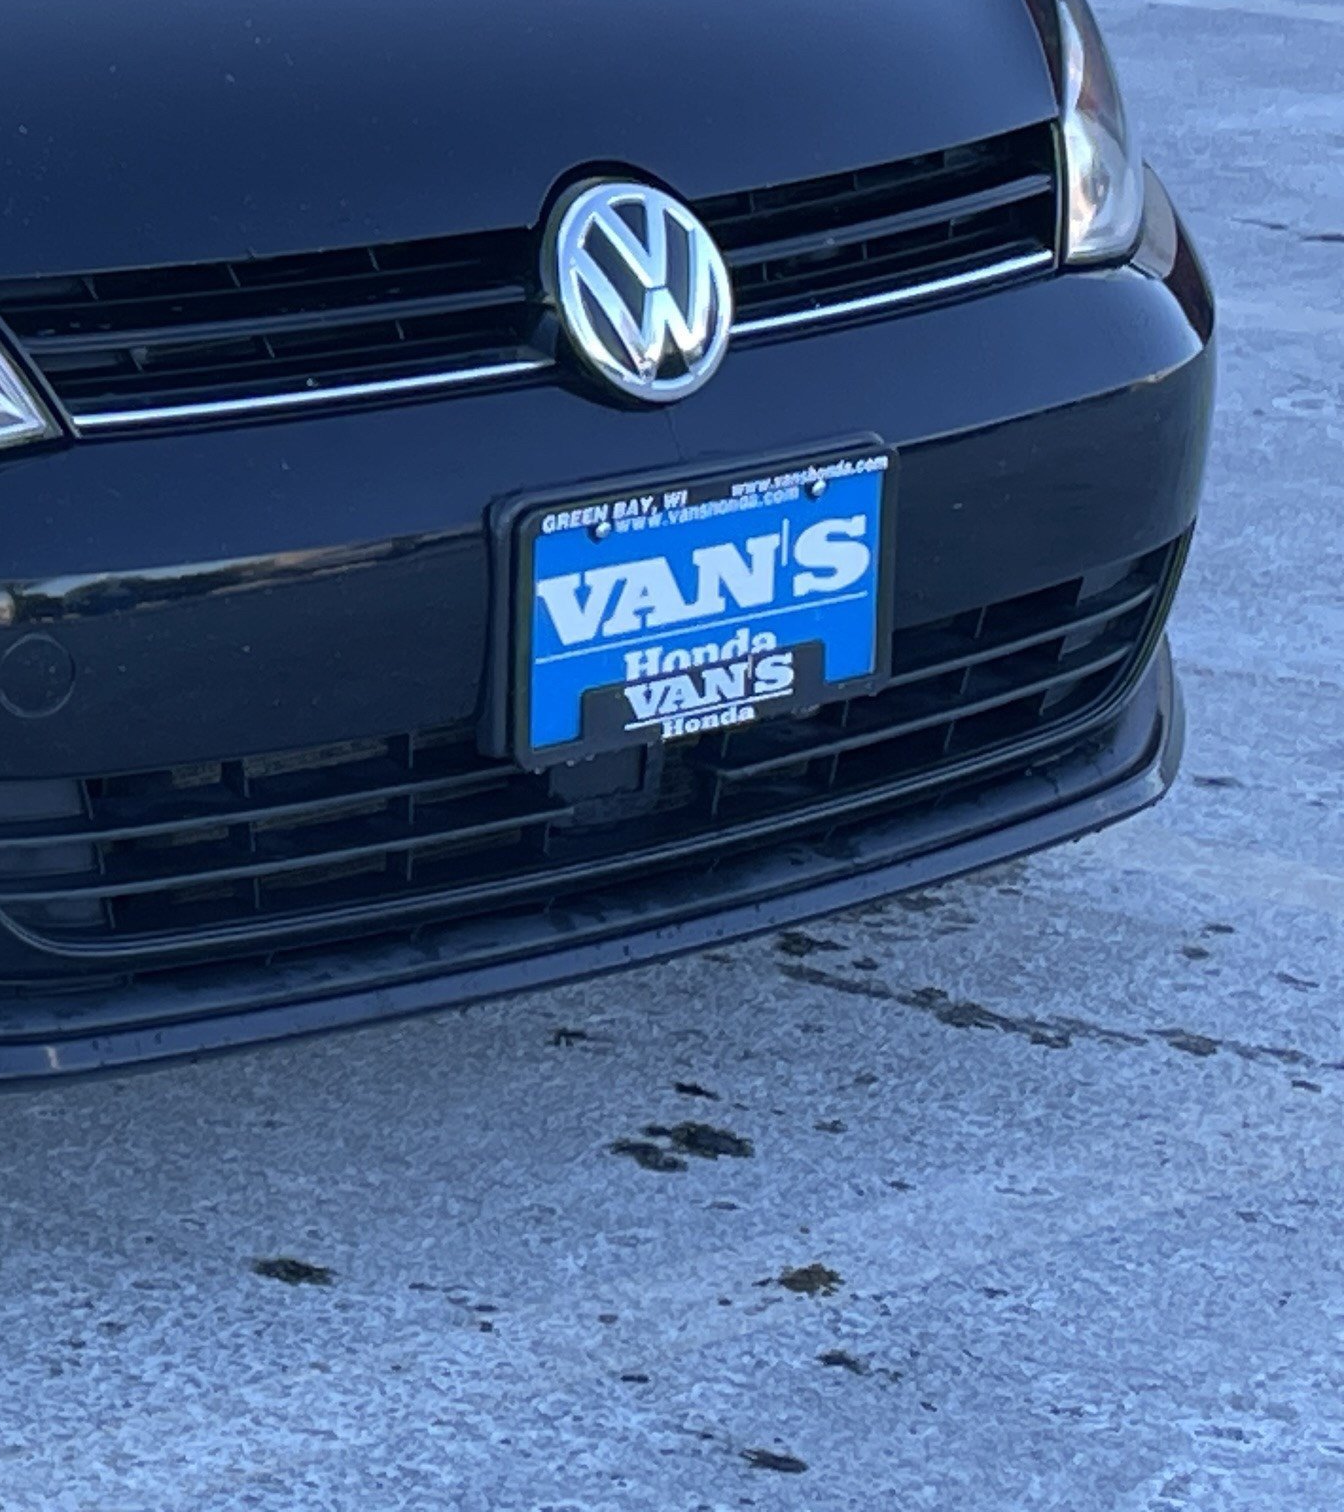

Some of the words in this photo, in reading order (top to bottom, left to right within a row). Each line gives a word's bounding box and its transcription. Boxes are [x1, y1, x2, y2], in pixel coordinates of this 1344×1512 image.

[541, 503, 609, 535] GREEN
[612, 495, 658, 519] BAY,
[663, 489, 689, 509] WI
[535, 513, 871, 646] VAN'S
[624, 628, 778, 681] Honda
[624, 651, 795, 719] VAN'S
[661, 705, 756, 740] Honda
